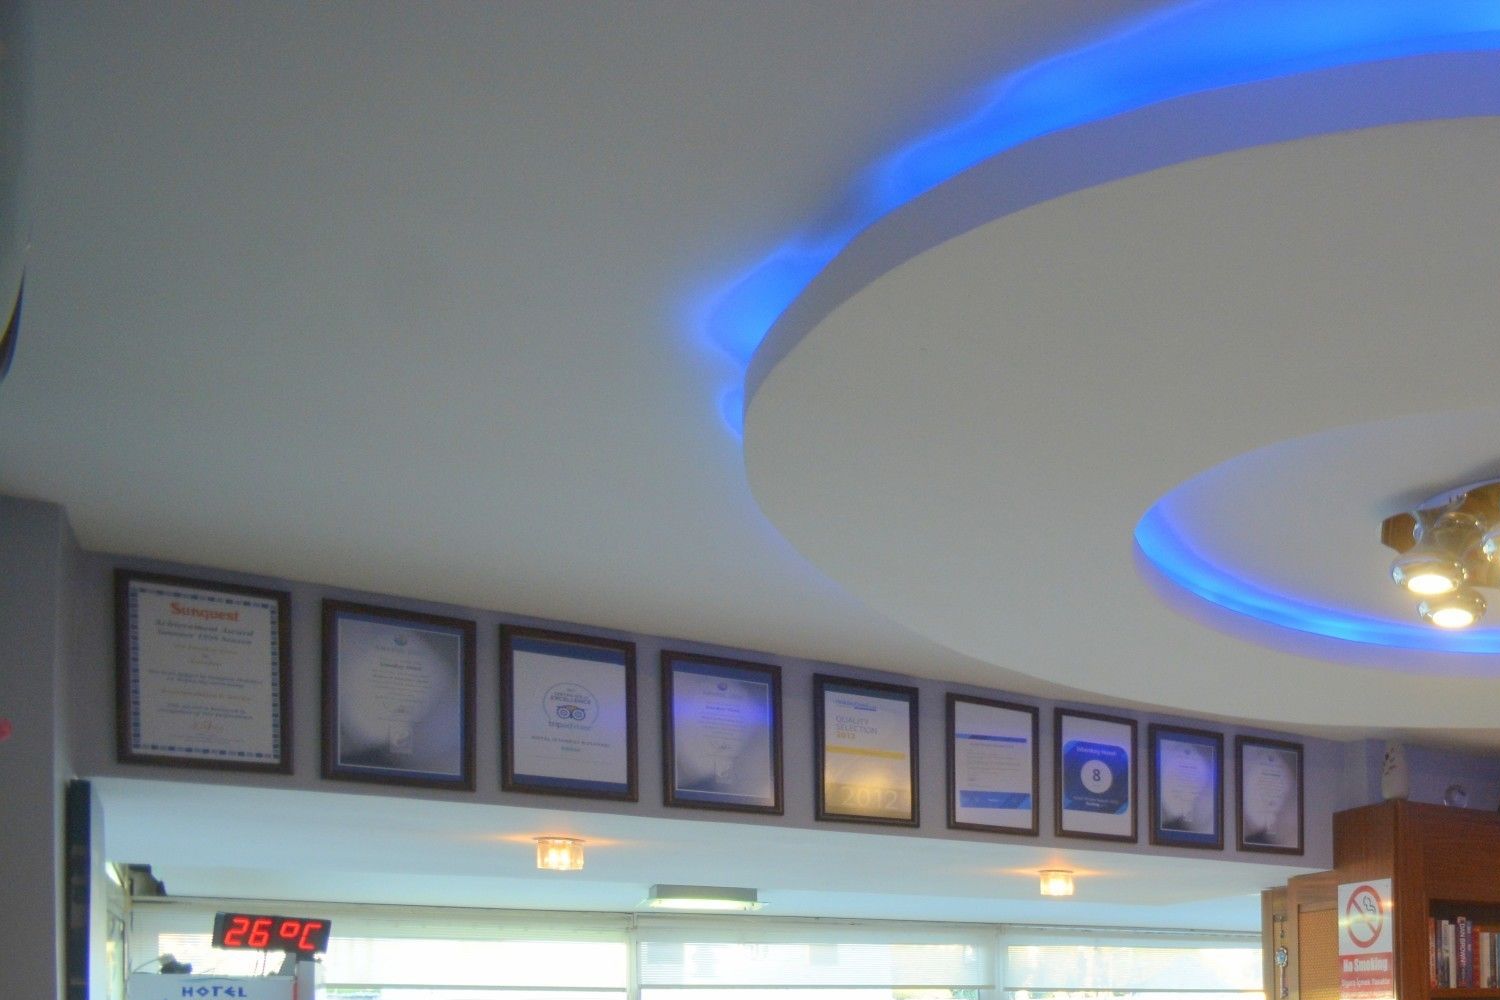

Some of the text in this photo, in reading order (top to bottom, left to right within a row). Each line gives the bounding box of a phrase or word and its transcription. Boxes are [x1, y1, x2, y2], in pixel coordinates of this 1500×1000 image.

[170, 602, 240, 621] Sunquest
[1092, 768, 1101, 782] 8
[841, 786, 898, 810] 2012
[223, 916, 273, 948] 26
[1459, 923, 1467, 937] DAN
[1459, 938, 1468, 963] BROWN
[1343, 956, 1388, 973] No Smoking
[182, 986, 247, 997] HOTEL
